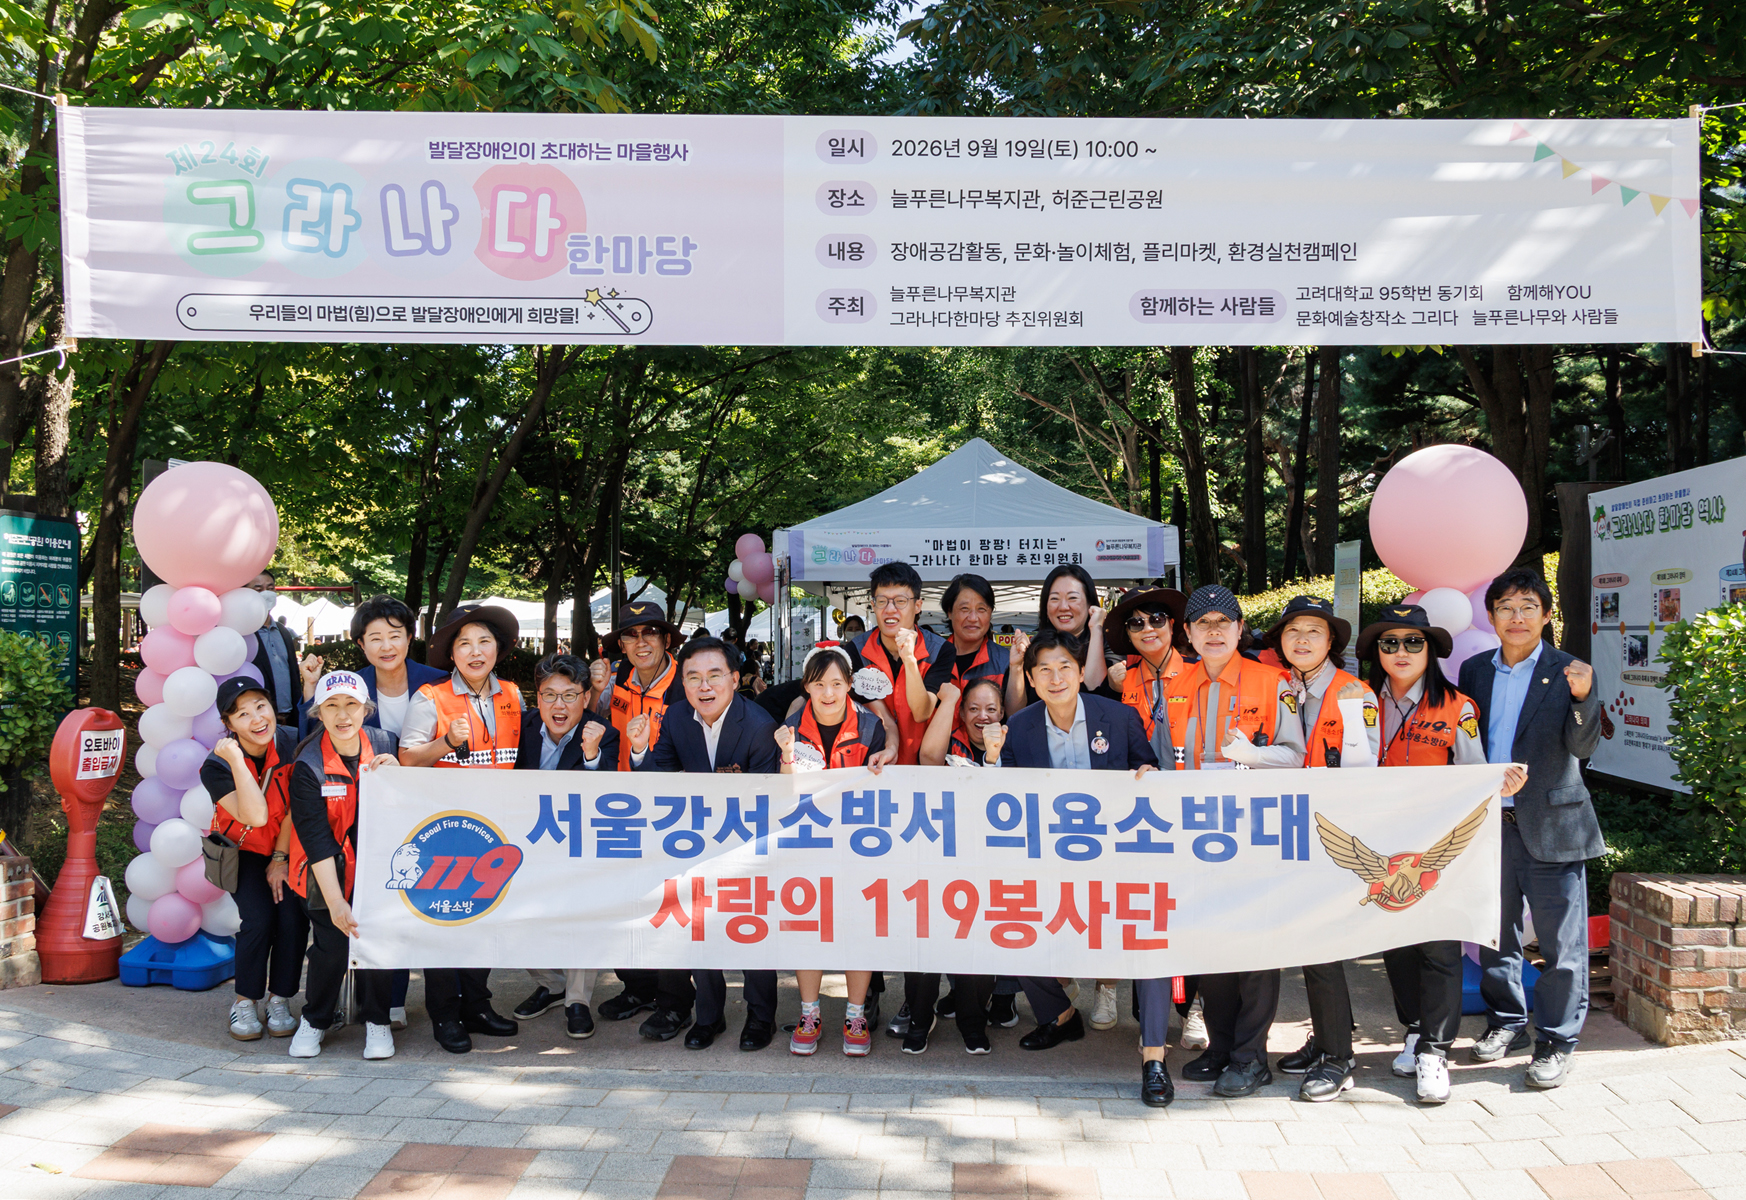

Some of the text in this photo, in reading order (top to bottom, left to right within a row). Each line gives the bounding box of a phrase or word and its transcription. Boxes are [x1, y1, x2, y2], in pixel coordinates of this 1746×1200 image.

[429, 142, 688, 161] 발달장애인이 초대하는 마을행사
[829, 138, 863, 157] 일시
[892, 139, 960, 157] 2026년
[968, 139, 997, 158] 9월
[1005, 139, 1078, 160] 19일(토)
[1086, 141, 1138, 157] 10:00
[165, 140, 270, 178] 제24회
[828, 189, 865, 208] 장소
[891, 189, 1162, 211] 늘푸른나무복지관, 허준근린공원
[185, 178, 698, 278] 그라나다 한마당
[829, 242, 864, 261] 내용
[891, 242, 1356, 264] 장애공감활동, 문화·놀이체험, 플리마켓, 환경실천캠페인
[890, 286, 1016, 302] 늘푸른나무복지관
[1296, 285, 1591, 302] 고려대학교 95학번 동기회 함께해YOU
[250, 305, 578, 324] 우리들의 마법(힘)으로 발달장애인에게 희망을!
[828, 297, 863, 316] 주최
[1141, 297, 1275, 316] 함께하는 사람들
[890, 311, 1082, 327] 그라나다한마당 추진위원회
[1296, 309, 1618, 326] 문화예술창작소 그리다 늘푸른나무와 사람들
[1611, 494, 1726, 540] 그라나다 한마당 역사
[45, 537, 72, 549] 이용안내
[979, 537, 1011, 551] 팡팡!
[1019, 537, 1066, 551] 터지는"
[909, 554, 962, 567] 그라나다
[969, 554, 1009, 567] 한마당
[1016, 553, 1083, 566] 추진위원회
[326, 675, 357, 686] GRAND
[613, 697, 628, 711] 강서
[1417, 720, 1447, 732] 119
[84, 737, 120, 752] 오토바이
[82, 756, 118, 772] 출입금지
[419, 819, 495, 844] Seoul Fire Services
[526, 791, 1310, 862] 서울강서소방서 의용소방대
[414, 845, 522, 899] 119
[429, 900, 474, 914] 서울소방
[649, 876, 1176, 951] 사랑의 119봉사단
